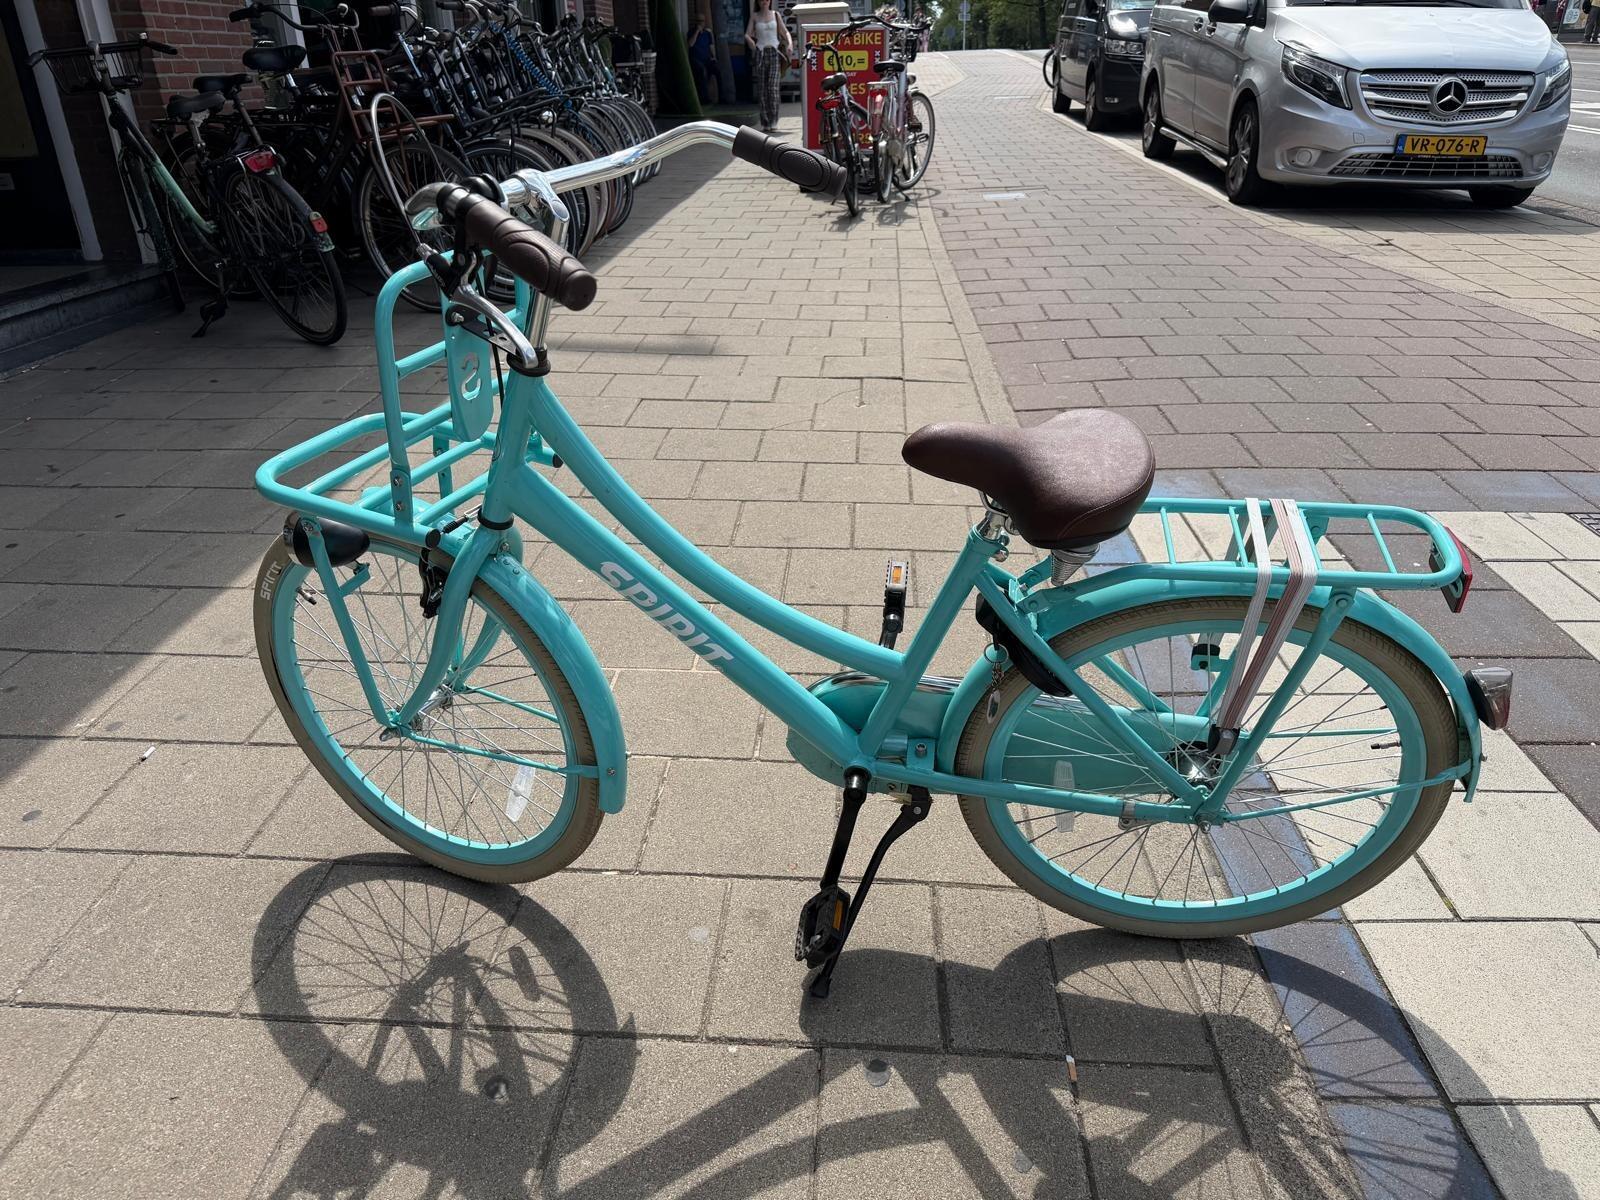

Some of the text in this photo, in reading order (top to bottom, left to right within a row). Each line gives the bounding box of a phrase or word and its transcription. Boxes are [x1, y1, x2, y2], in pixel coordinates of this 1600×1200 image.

[853, 32, 882, 46] BIKE
[1410, 138, 1480, 153] VR-076-R
[260, 561, 282, 601] SPIRIT
[600, 561, 735, 661] SPIRIT
